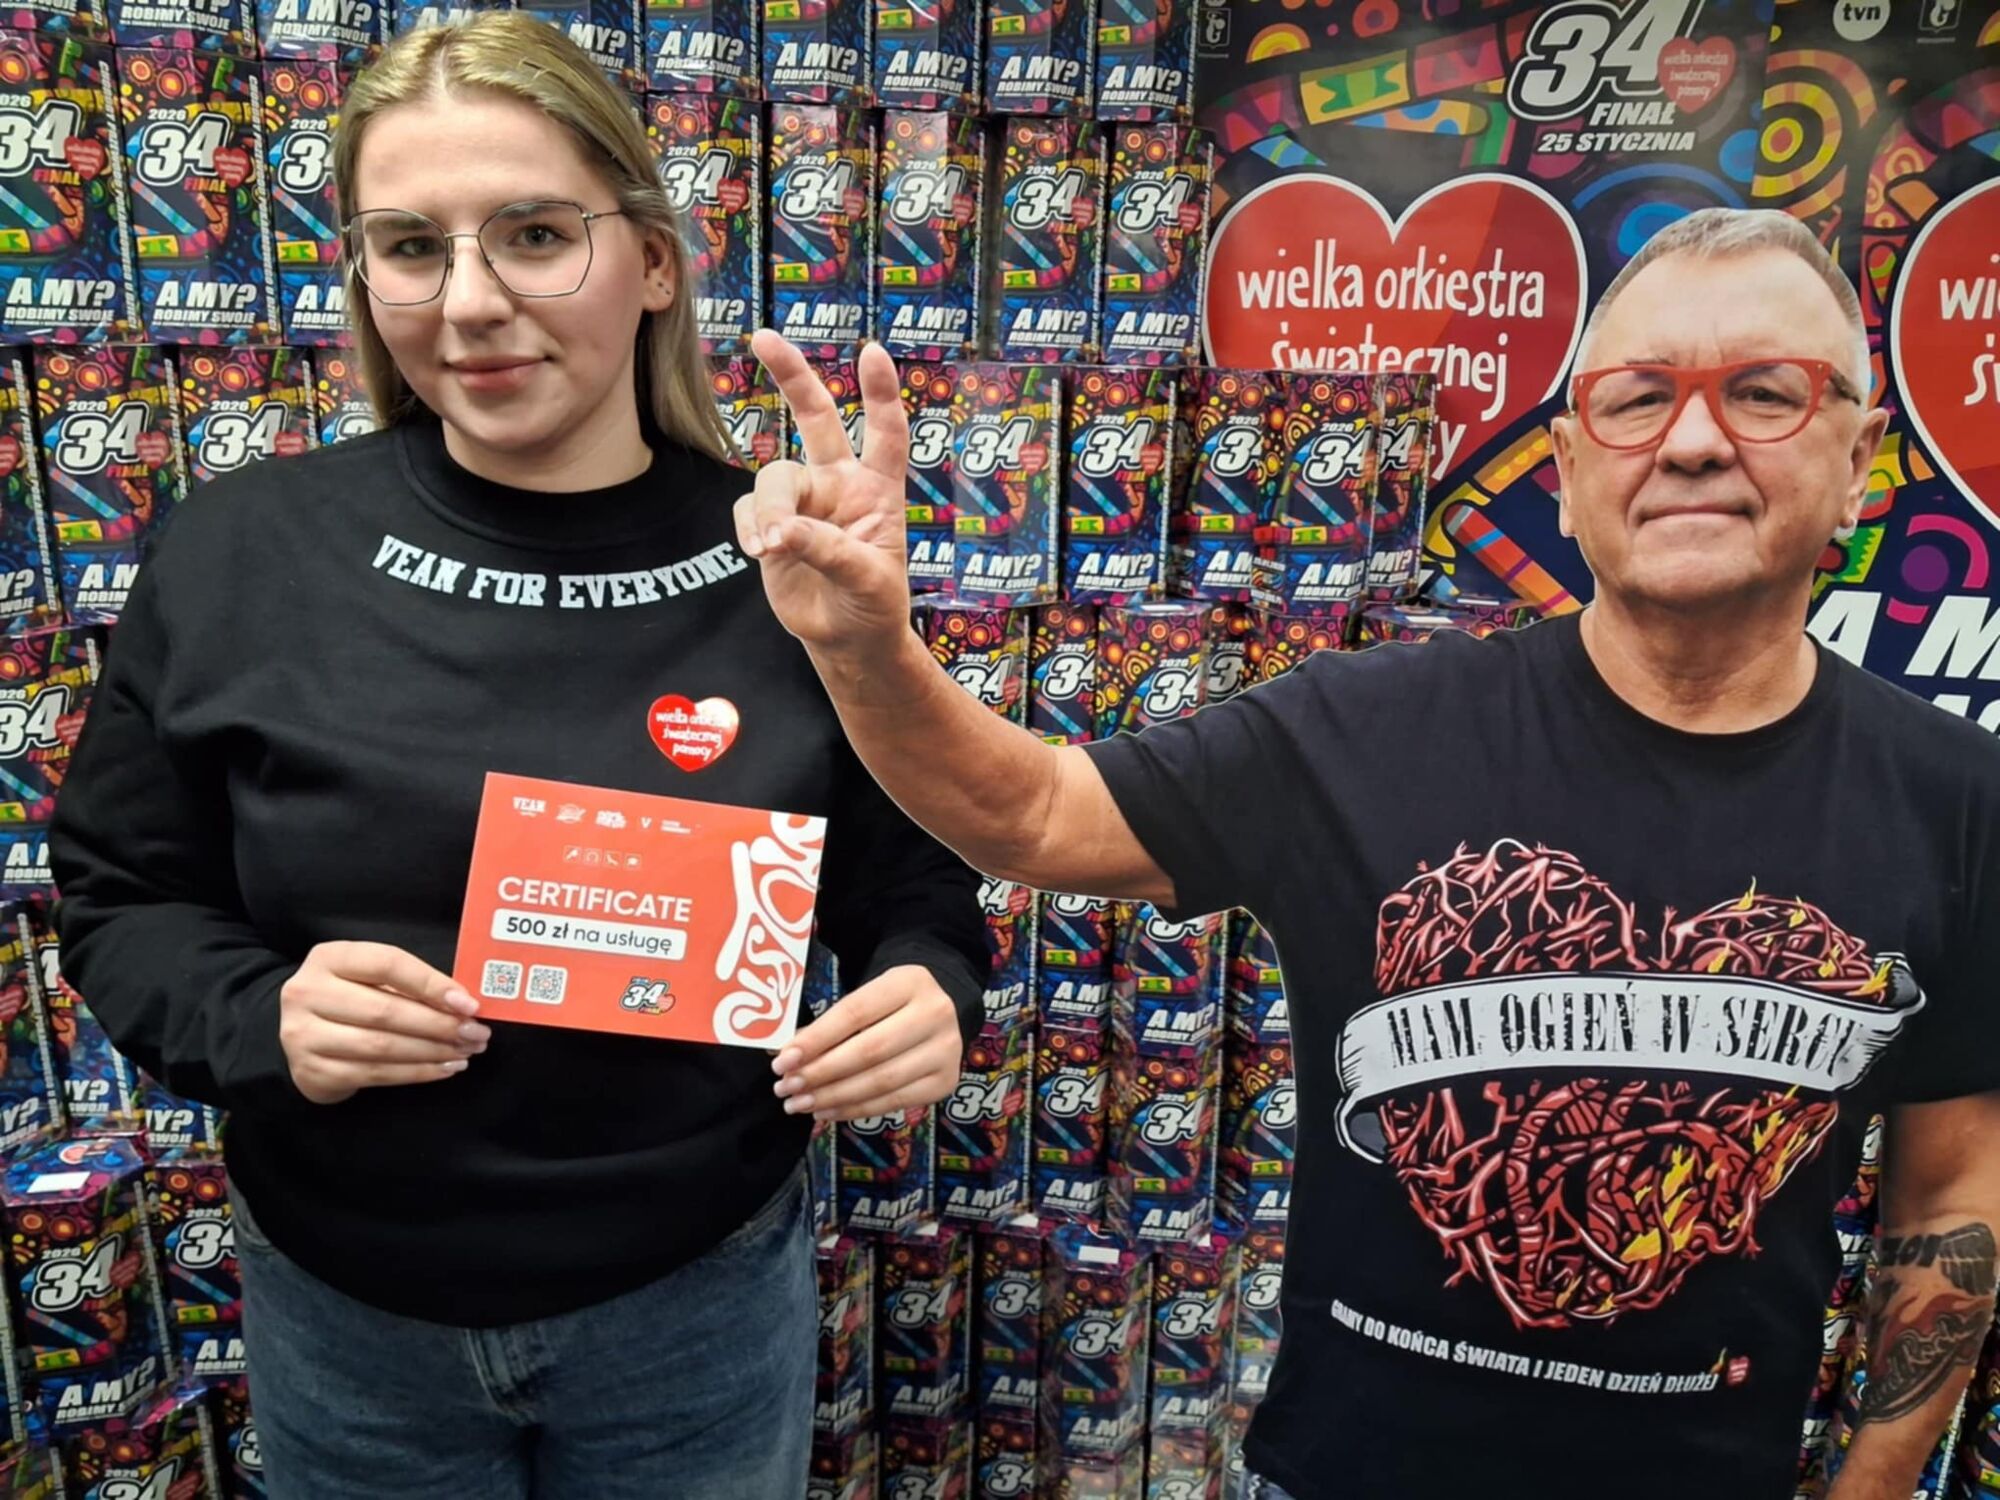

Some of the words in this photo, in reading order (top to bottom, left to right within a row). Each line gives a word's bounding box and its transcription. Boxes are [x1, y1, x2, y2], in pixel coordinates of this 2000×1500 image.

[121, 6, 184, 23] ROBIMY
[186, 10, 231, 30] SWOJE
[275, 0, 299, 20] A
[306, 0, 373, 28] MY?
[1843, 3, 1881, 21] tvn
[271, 22, 330, 37] ROBIMY
[333, 26, 371, 44] SWOJE
[658, 31, 682, 57] A
[687, 32, 744, 61] MY?
[777, 43, 800, 67] A
[803, 44, 858, 73] MY?
[888, 51, 910, 74] A
[914, 51, 967, 78] MY?
[1001, 55, 1026, 79] A
[1028, 56, 1080, 82] MY?
[1509, 0, 1700, 119] 34
[773, 69, 820, 83] ROBIMY
[884, 76, 931, 88] ROBIMY
[997, 80, 1045, 94] ROBIMY
[1106, 65, 1129, 88] A
[1132, 66, 1182, 91] MY?
[1101, 89, 1150, 102] ROBIMY
[148, 109, 186, 122] 2026
[290, 118, 327, 131] 2026
[1589, 101, 1677, 126] FINAŁ
[0, 103, 81, 175] 34
[138, 114, 231, 186] 34
[1538, 133, 1573, 152] 25
[1576, 131, 1696, 152] STYCZNIA
[667, 146, 699, 157] 2026
[794, 155, 826, 166] 2026
[905, 160, 937, 171] 2026
[1025, 165, 1056, 176] 2026
[1133, 170, 1165, 181] 2026
[664, 150, 731, 210] 34
[781, 161, 853, 219] 34
[891, 166, 964, 224] 34
[1012, 169, 1084, 228] 34
[1117, 175, 1191, 233] 34
[1237, 238, 1364, 309] wielka
[1374, 246, 1545, 318] orkiestra
[7, 278, 33, 305] A
[40, 278, 116, 307] MY?
[156, 281, 179, 307] A
[186, 282, 258, 310] MY?
[295, 285, 318, 310] A
[4, 307, 68, 320] ROBIMY
[68, 309, 115, 322] SWOJE
[153, 309, 209, 322] ROBIMY
[211, 311, 256, 324] SWOJE
[786, 302, 807, 325] A
[812, 303, 862, 327] MY?
[893, 306, 914, 328] A
[918, 306, 967, 329] MY?
[1013, 308, 1034, 330] A
[1037, 309, 1088, 332] MY?
[1115, 312, 1137, 333] A
[1139, 313, 1189, 335] MY?
[783, 326, 831, 338] ROBIMY
[889, 329, 935, 340] ROBIMY
[67, 400, 107, 412] 2026
[210, 400, 249, 411] 2026
[919, 408, 949, 417] 2026
[972, 414, 1000, 424] 2026
[1094, 415, 1125, 425] 2026
[1227, 416, 1260, 425] 2026
[1320, 423, 1354, 432] 2026
[57, 403, 148, 474] 34
[201, 403, 287, 471] 34
[960, 418, 1032, 476] 34
[1079, 418, 1152, 476] 34
[1303, 427, 1373, 486] 34
[912, 541, 931, 562] A
[1208, 550, 1230, 571] A
[79, 564, 104, 588] A
[371, 534, 467, 594] VEAN
[468, 566, 547, 607] FOR
[559, 542, 748, 608] EVERYONE
[965, 554, 985, 575] A
[988, 554, 1042, 577] MY?
[1081, 553, 1101, 574] A
[1104, 554, 1153, 577] MY?
[1298, 563, 1322, 584] A
[962, 575, 1005, 587] ROBIMY
[1076, 575, 1119, 587] ROBIMY
[957, 653, 989, 663] 2026
[1055, 643, 1086, 652] 2026
[1158, 658, 1189, 668] 2026
[952, 653, 1012, 705] 34
[6, 843, 28, 867] A
[497, 876, 693, 923] CERTIFICATE
[506, 916, 546, 936] 500
[552, 923, 569, 939] zł
[574, 927, 600, 943] na
[606, 930, 672, 955] usługę
[621, 978, 670, 1012] 34
[1054, 982, 1074, 1000] A
[1147, 1010, 1169, 1029] A
[1500, 981, 1637, 1056] OGIEŃ
[1661, 993, 1701, 1053] W
[946, 1073, 1013, 1123] 34
[1143, 1092, 1207, 1145] 34
[949, 1187, 967, 1204] A
[1046, 1179, 1065, 1197] A
[853, 1197, 872, 1216] A
[1143, 1209, 1162, 1228] A
[33, 1234, 121, 1311] 34
[891, 1282, 953, 1329] 34
[1163, 1293, 1222, 1339] 34
[1071, 1311, 1132, 1359] 34
[197, 1340, 219, 1360] A
[1364, 1316, 1386, 1341] DO
[1387, 1325, 1450, 1360] KOŃCA
[1453, 1341, 1530, 1376] ŚWIATA
[1533, 1359, 1544, 1378] I
[1544, 1360, 1605, 1388] JEDEN
[1606, 1372, 1663, 1394] DZIEŃ
[1663, 1371, 1719, 1394] DŁUŻEJ
[60, 1385, 83, 1408] A
[91, 1356, 156, 1405] MY?
[897, 1386, 913, 1401] A
[994, 1376, 1010, 1391] A
[1163, 1397, 1183, 1414] A
[1072, 1417, 1089, 1433] A
